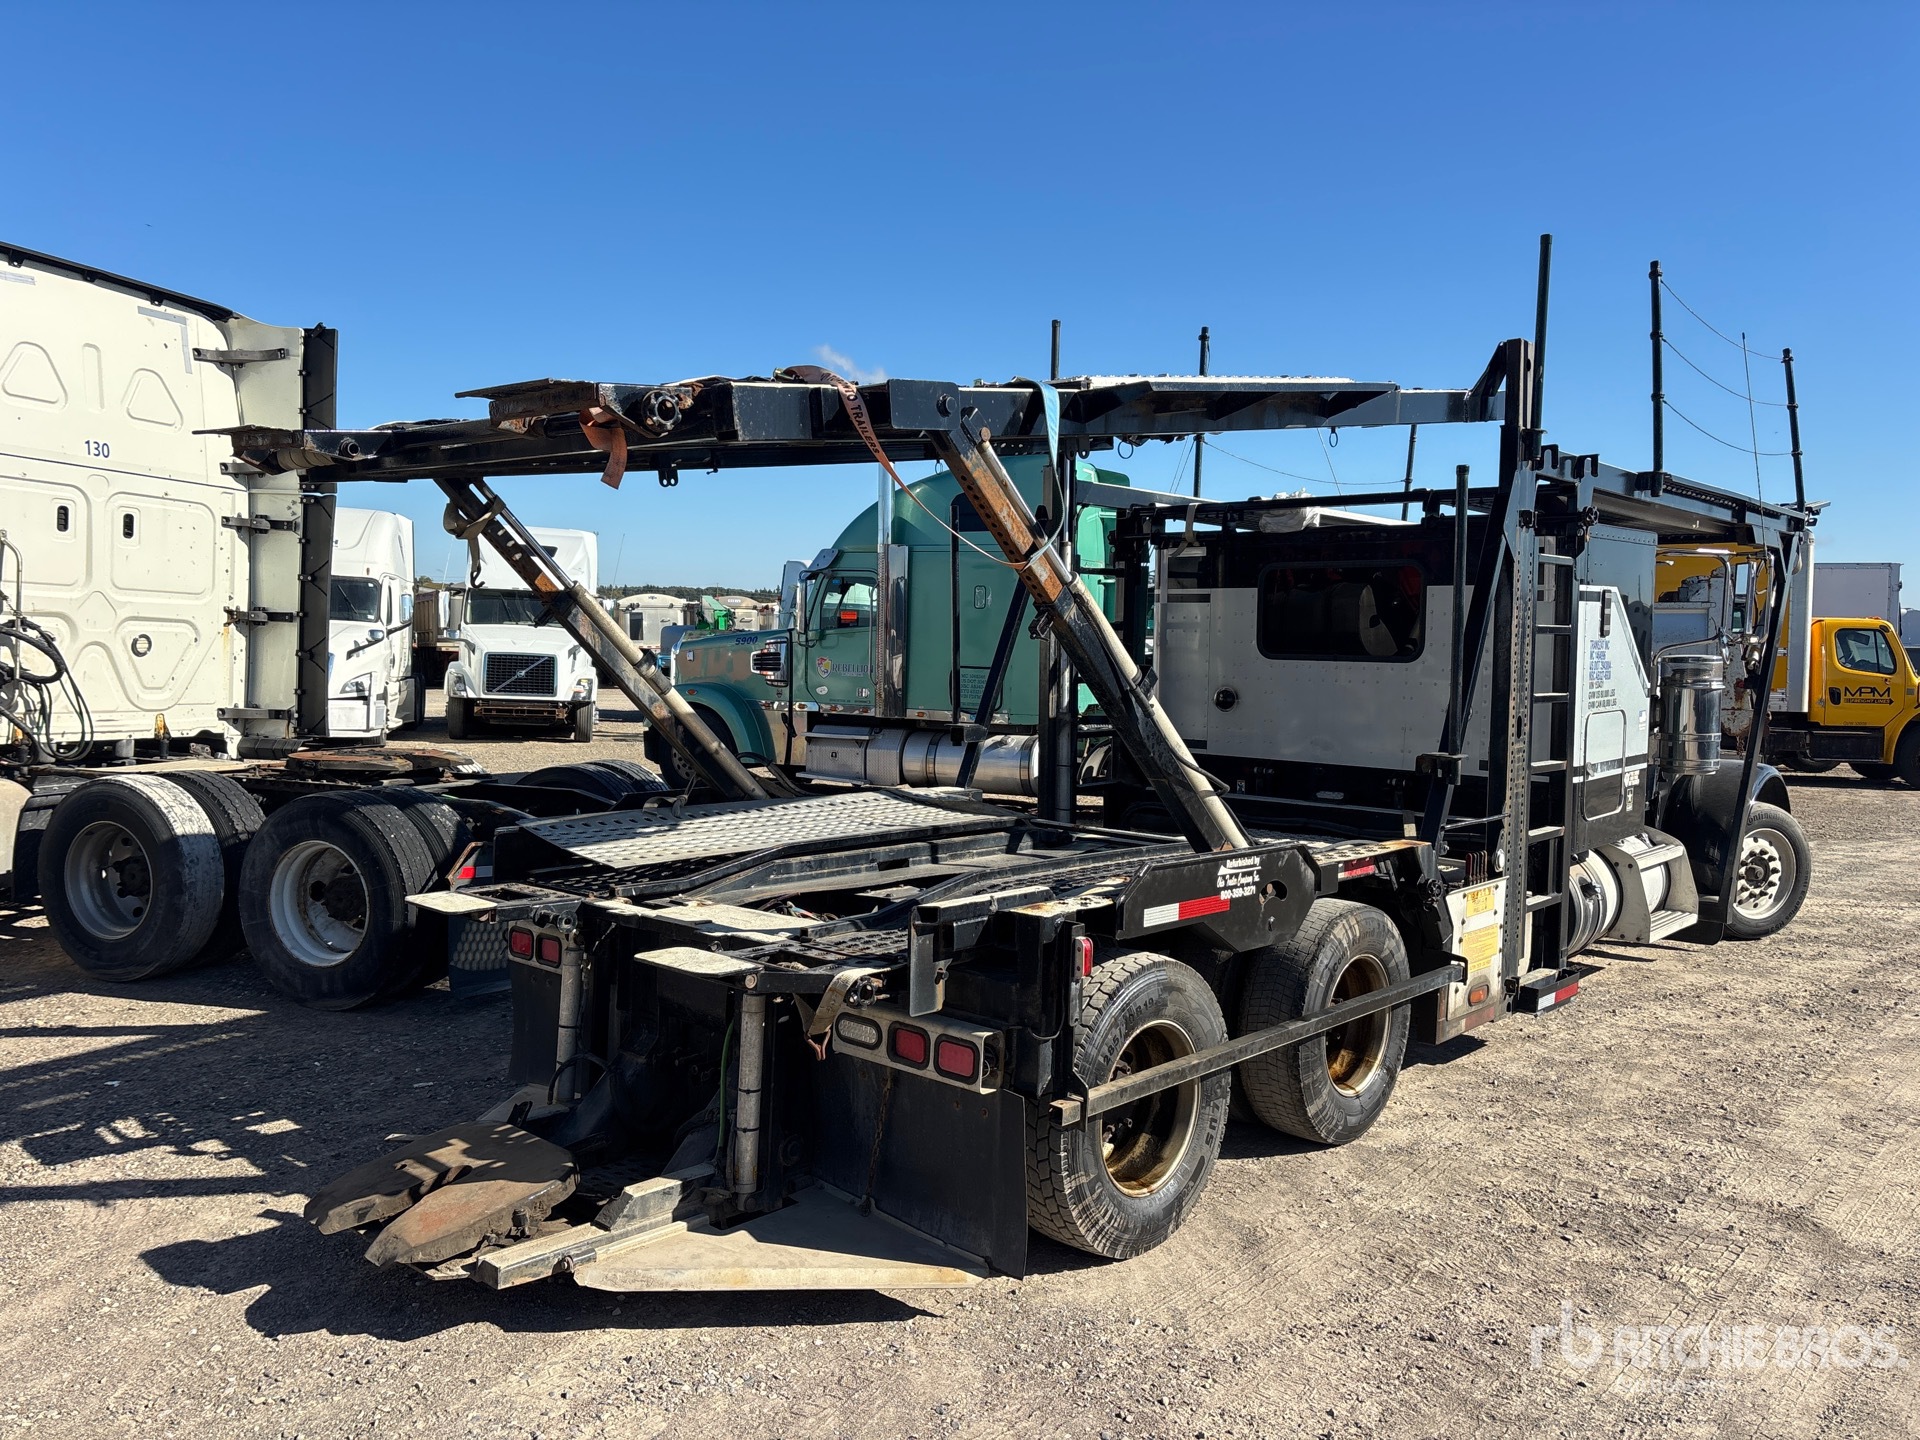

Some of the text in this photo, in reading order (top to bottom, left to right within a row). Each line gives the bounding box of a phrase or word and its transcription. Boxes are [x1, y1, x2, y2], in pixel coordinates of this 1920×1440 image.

[851, 405, 880, 454] TRAILERS
[84, 440, 110, 458] 130
[735, 635, 759, 646] 5900
[1844, 686, 1891, 698] MPM
[1227, 856, 1260, 868] Refurbished by
